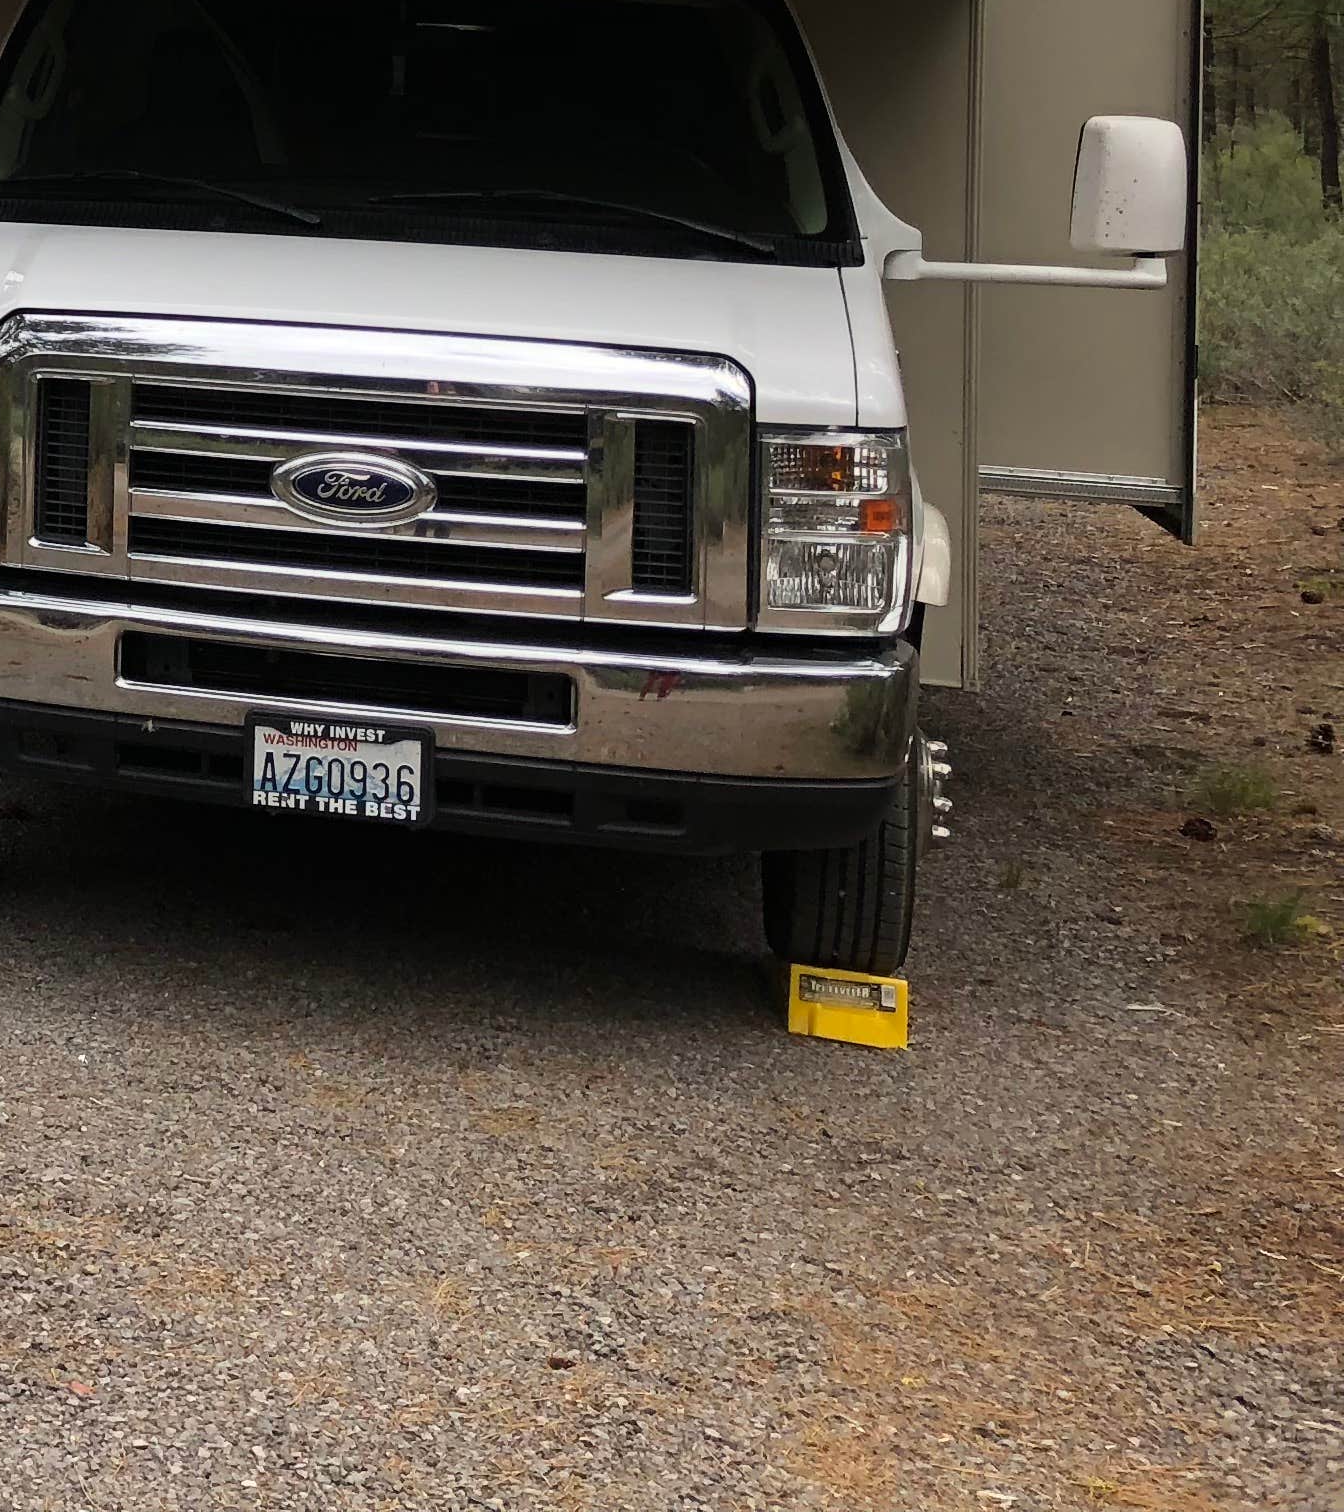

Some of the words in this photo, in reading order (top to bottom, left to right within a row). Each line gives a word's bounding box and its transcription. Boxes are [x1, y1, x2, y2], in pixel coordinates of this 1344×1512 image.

[317, 470, 388, 503] Ford
[263, 733, 359, 752] WASHINGTON
[290, 721, 325, 737] WHY
[329, 725, 386, 743] INVEST
[260, 751, 415, 804] AZG0936
[253, 790, 309, 810] RENT
[315, 796, 358, 815] THE
[365, 801, 421, 821] BEST
